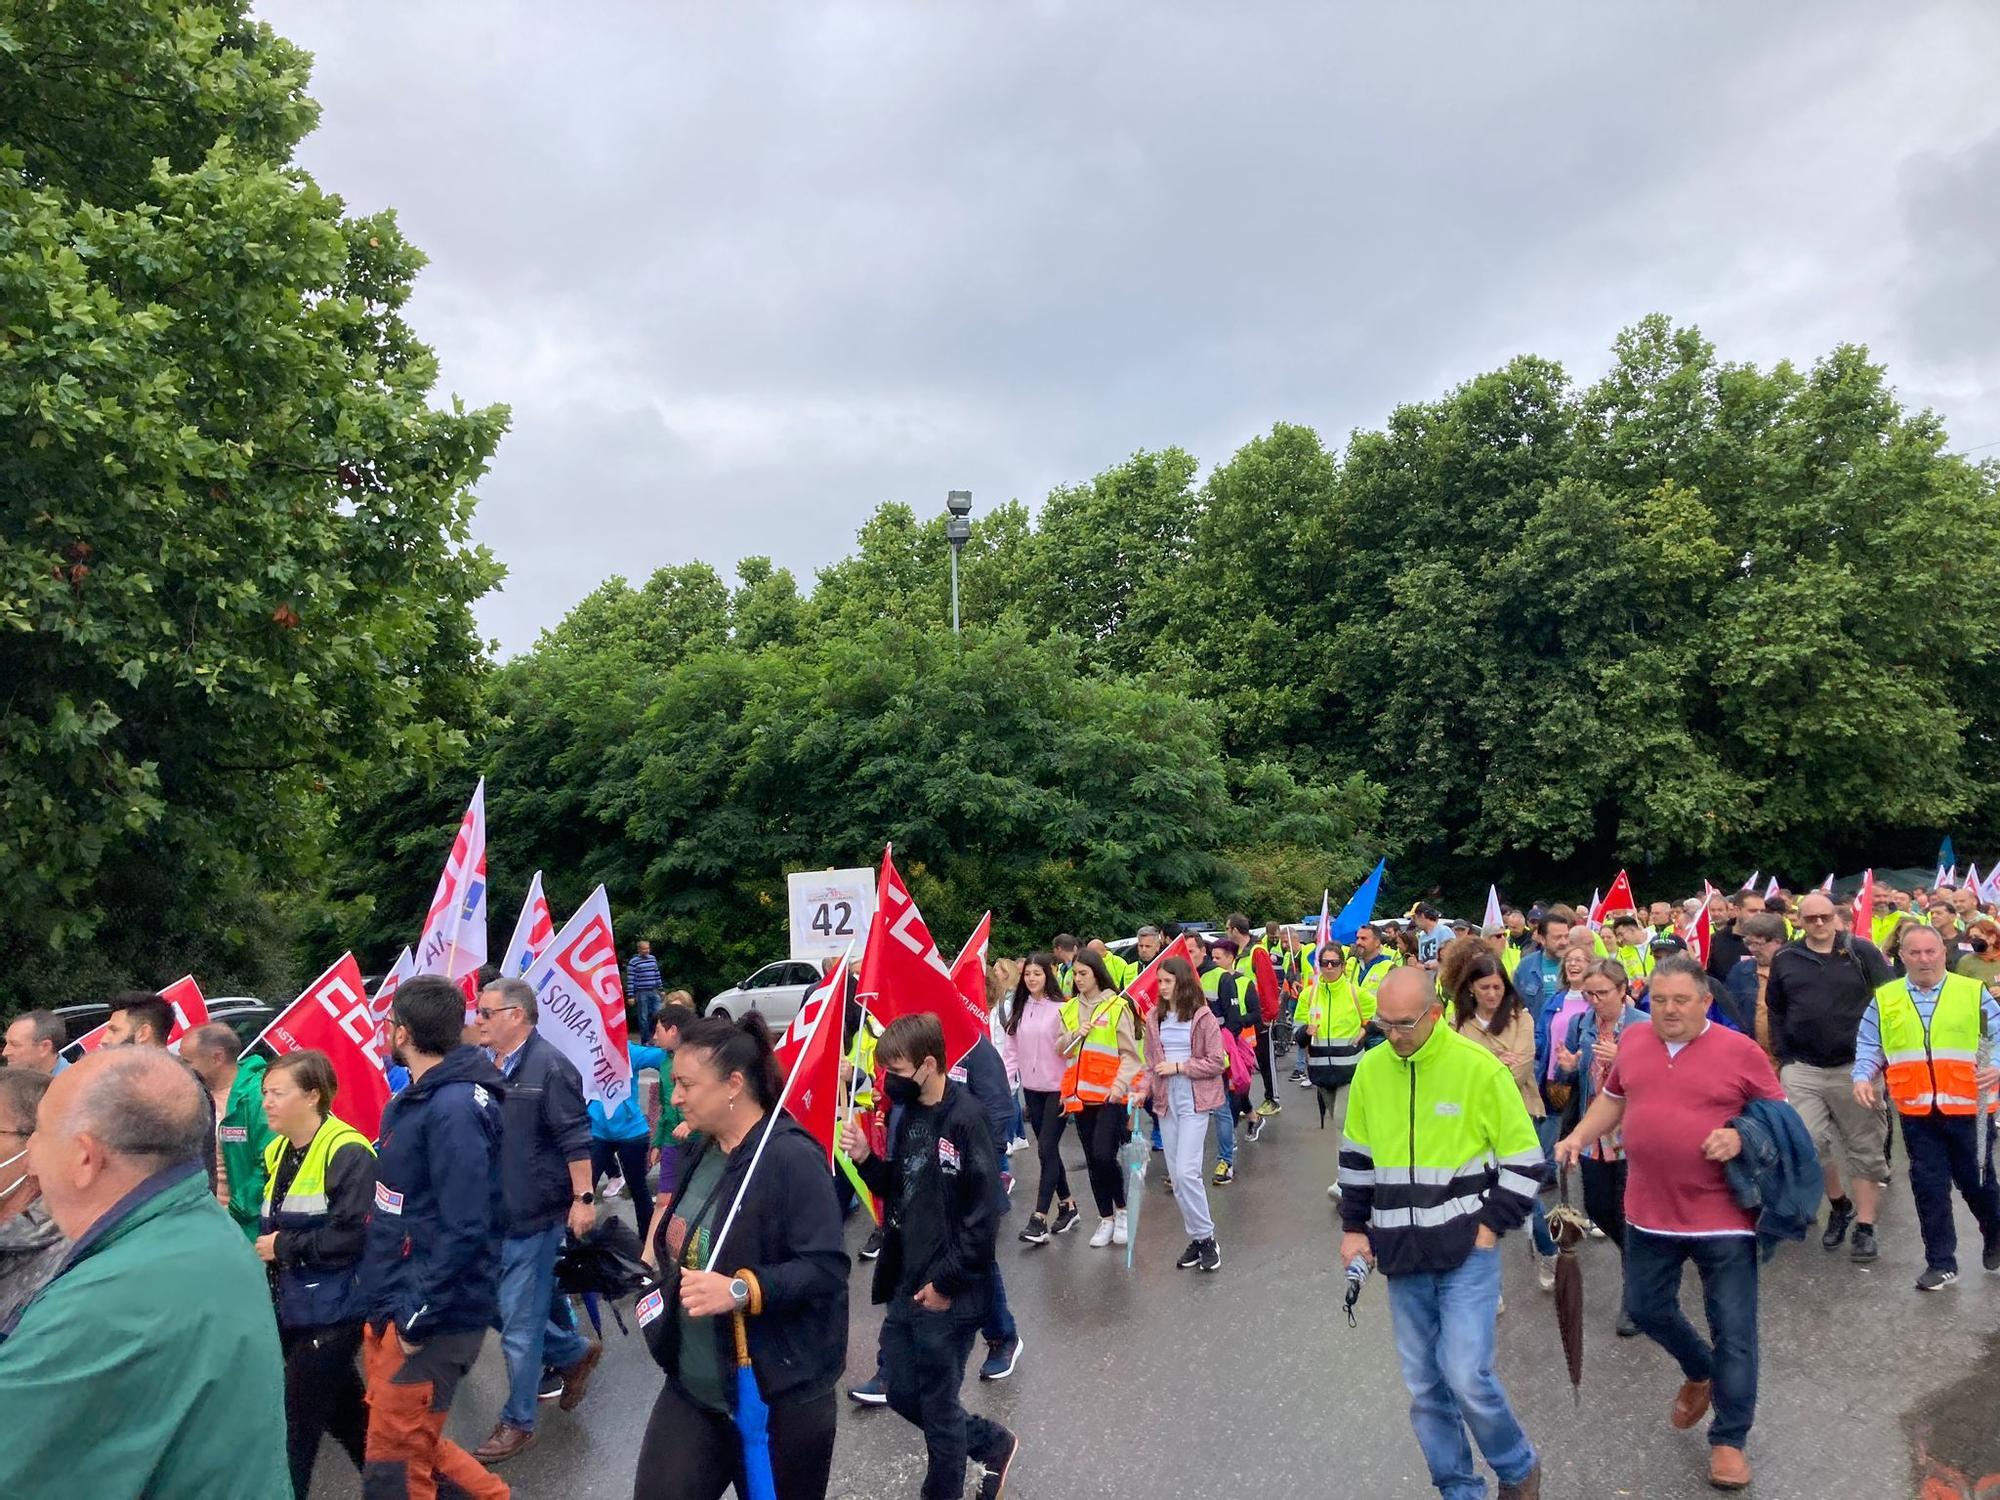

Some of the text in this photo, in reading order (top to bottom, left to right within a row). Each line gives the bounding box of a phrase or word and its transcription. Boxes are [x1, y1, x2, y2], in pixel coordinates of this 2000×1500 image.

[812, 901, 854, 936] 42
[542, 984, 593, 1037] SOMA
[590, 1044, 625, 1100] FITAG
